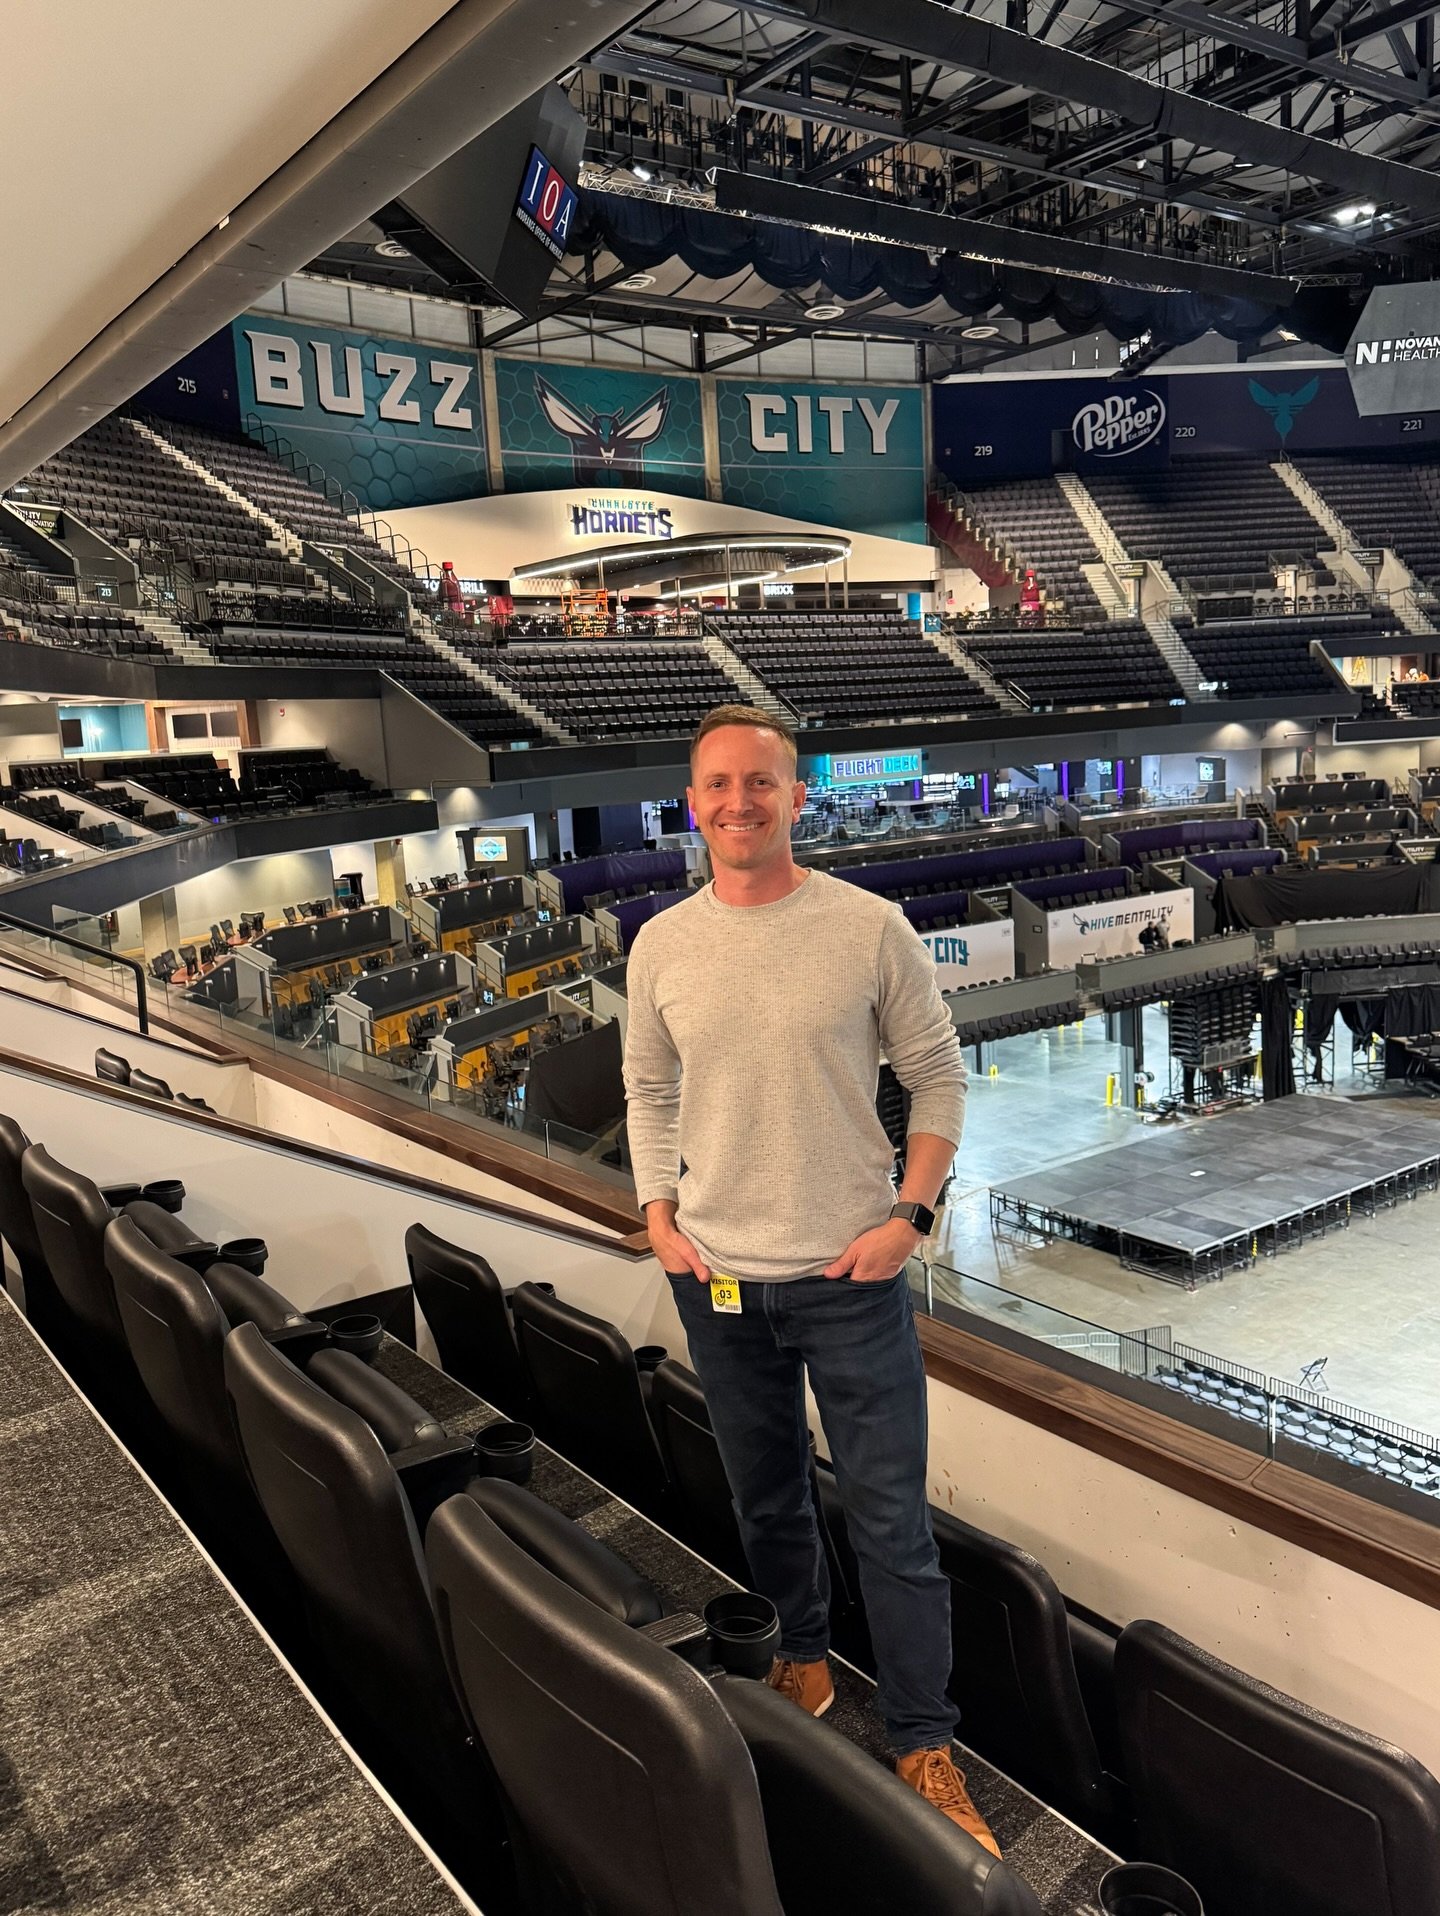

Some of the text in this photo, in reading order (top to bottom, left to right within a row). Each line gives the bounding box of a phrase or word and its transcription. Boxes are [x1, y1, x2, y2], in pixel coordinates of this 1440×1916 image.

[527, 161, 572, 240] IOA
[177, 377, 197, 394] 215
[243, 330, 474, 430] BUZZ
[1104, 395, 1137, 426] Dr
[744, 393, 900, 454] CITY
[1072, 403, 1159, 453] Pepper
[1175, 427, 1196, 438] 220
[1402, 419, 1422, 431] 221
[974, 446, 993, 456] 219
[569, 505, 674, 539] HORNETS
[101, 588, 112, 597] 213
[834, 758, 882, 778] FLIGHT
[935, 937, 970, 967] CITY
[710, 1278, 738, 1286] VISITOR
[720, 1289, 732, 1299] 03
